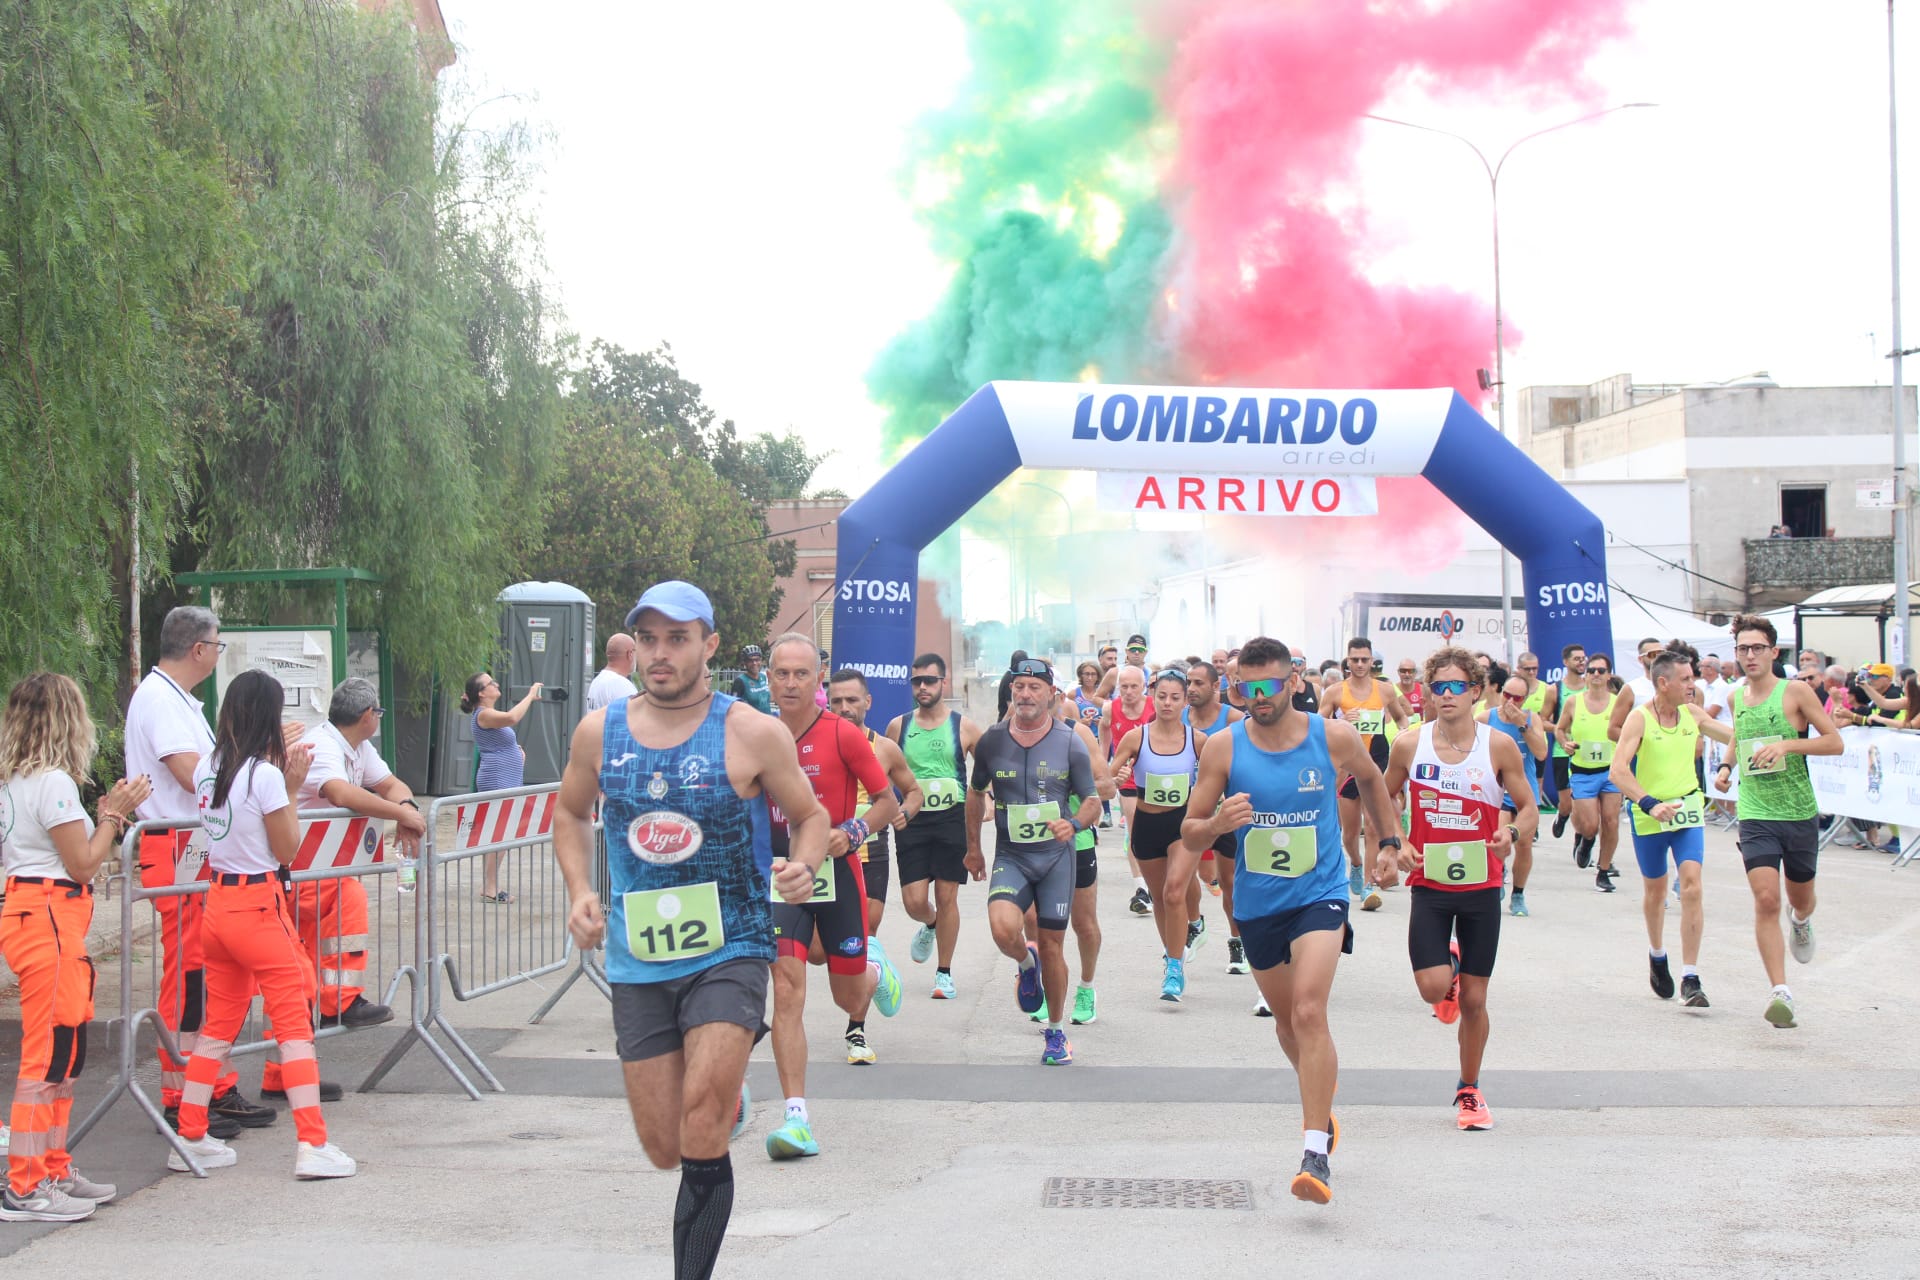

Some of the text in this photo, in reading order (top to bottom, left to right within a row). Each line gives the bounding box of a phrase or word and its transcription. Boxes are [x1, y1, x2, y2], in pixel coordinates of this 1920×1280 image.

[1072, 393, 1377, 445] LOMBARDO
[1282, 447, 1375, 465] arredi
[1135, 476, 1340, 512] ARRIVO
[841, 579, 911, 602] STOSA
[1539, 582, 1607, 606] STOSA
[847, 606, 904, 615] CUCINE
[1549, 608, 1603, 618] CUCINE
[1379, 616, 1464, 632] LOMBARO
[1353, 722, 1379, 731] 127
[1590, 752, 1602, 760] 11
[1153, 790, 1181, 803] 36
[1018, 822, 1047, 839] 37
[1271, 850, 1291, 871] 2
[1447, 863, 1465, 880] 6
[813, 878, 828, 896] 2
[640, 920, 709, 954] 112
